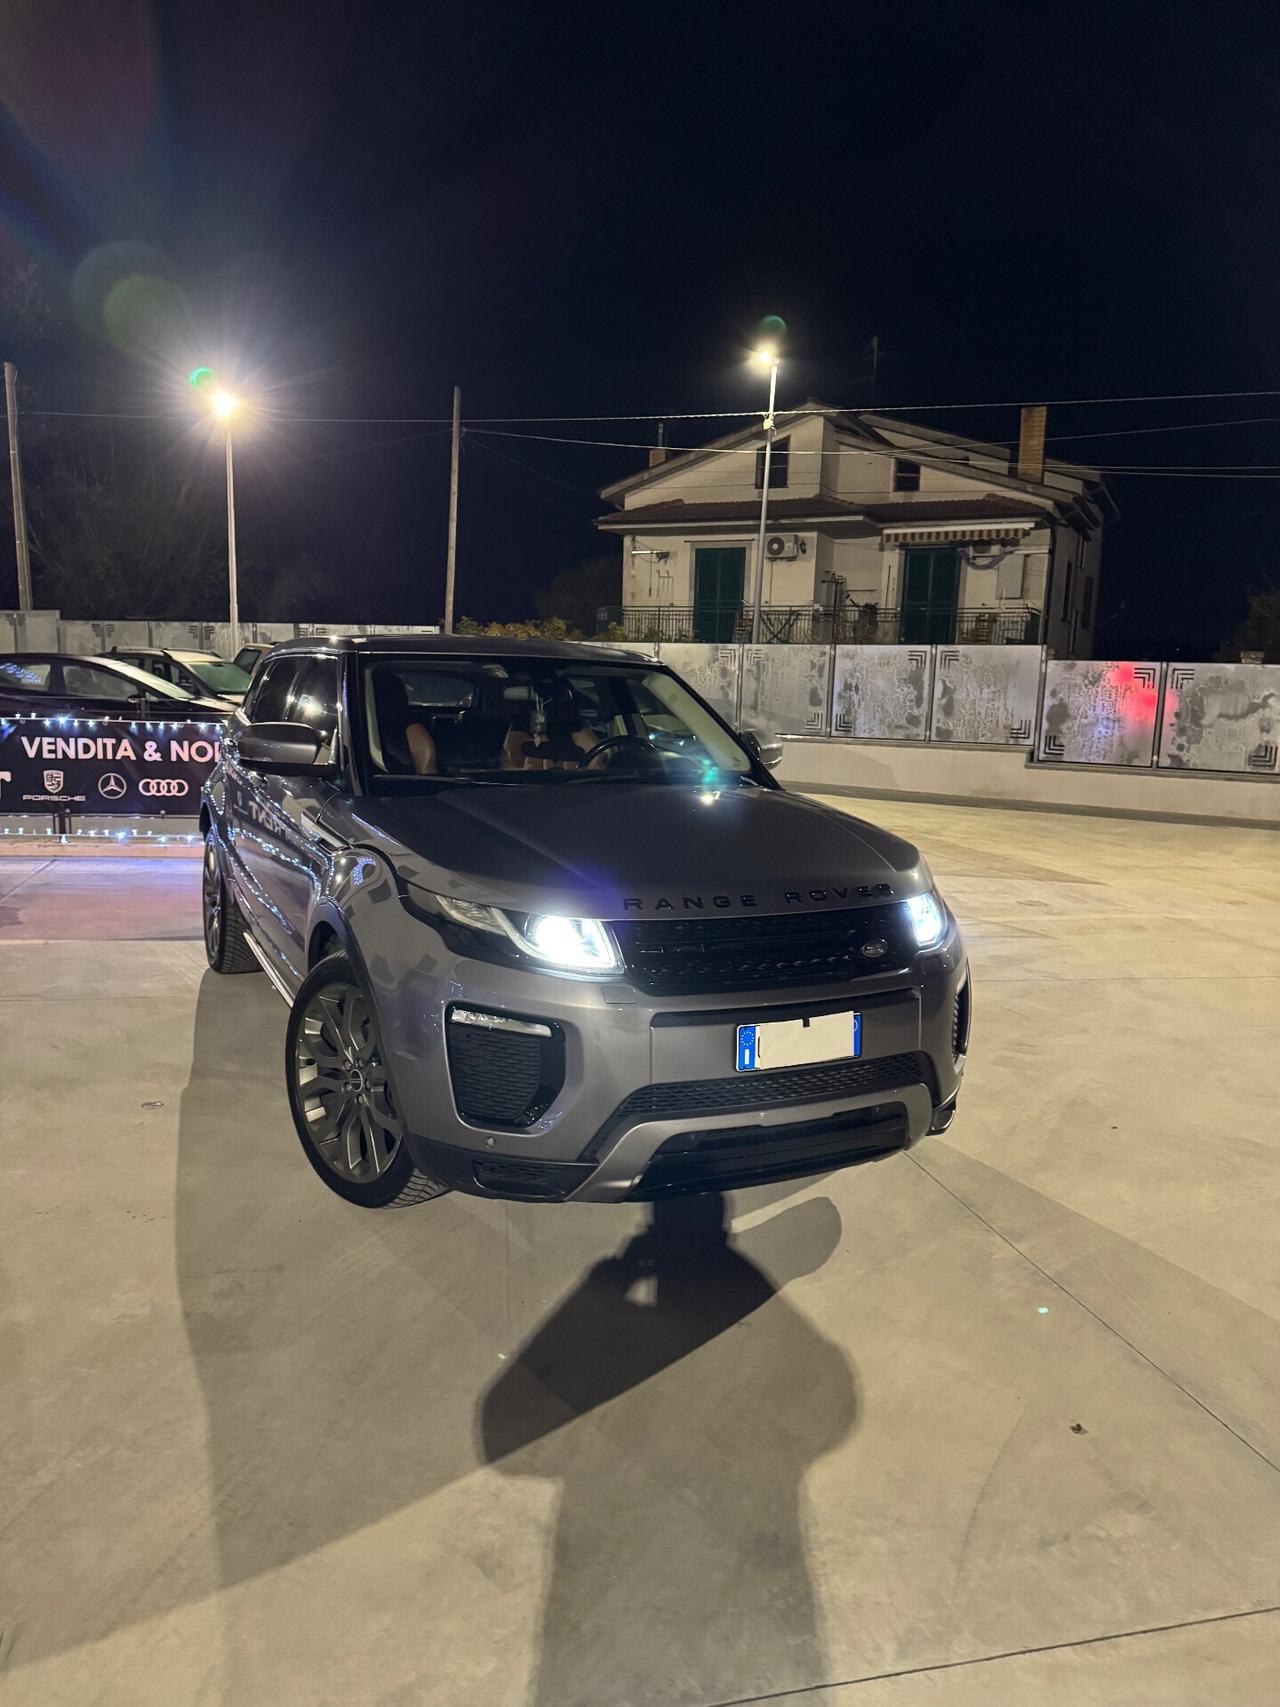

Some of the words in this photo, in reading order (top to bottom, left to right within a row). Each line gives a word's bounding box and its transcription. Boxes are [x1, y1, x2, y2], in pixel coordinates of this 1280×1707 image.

[21, 736, 136, 761] VENDITA
[143, 740, 162, 761] &
[622, 894, 758, 911] RANGE
[783, 882, 895, 904] ROVER
